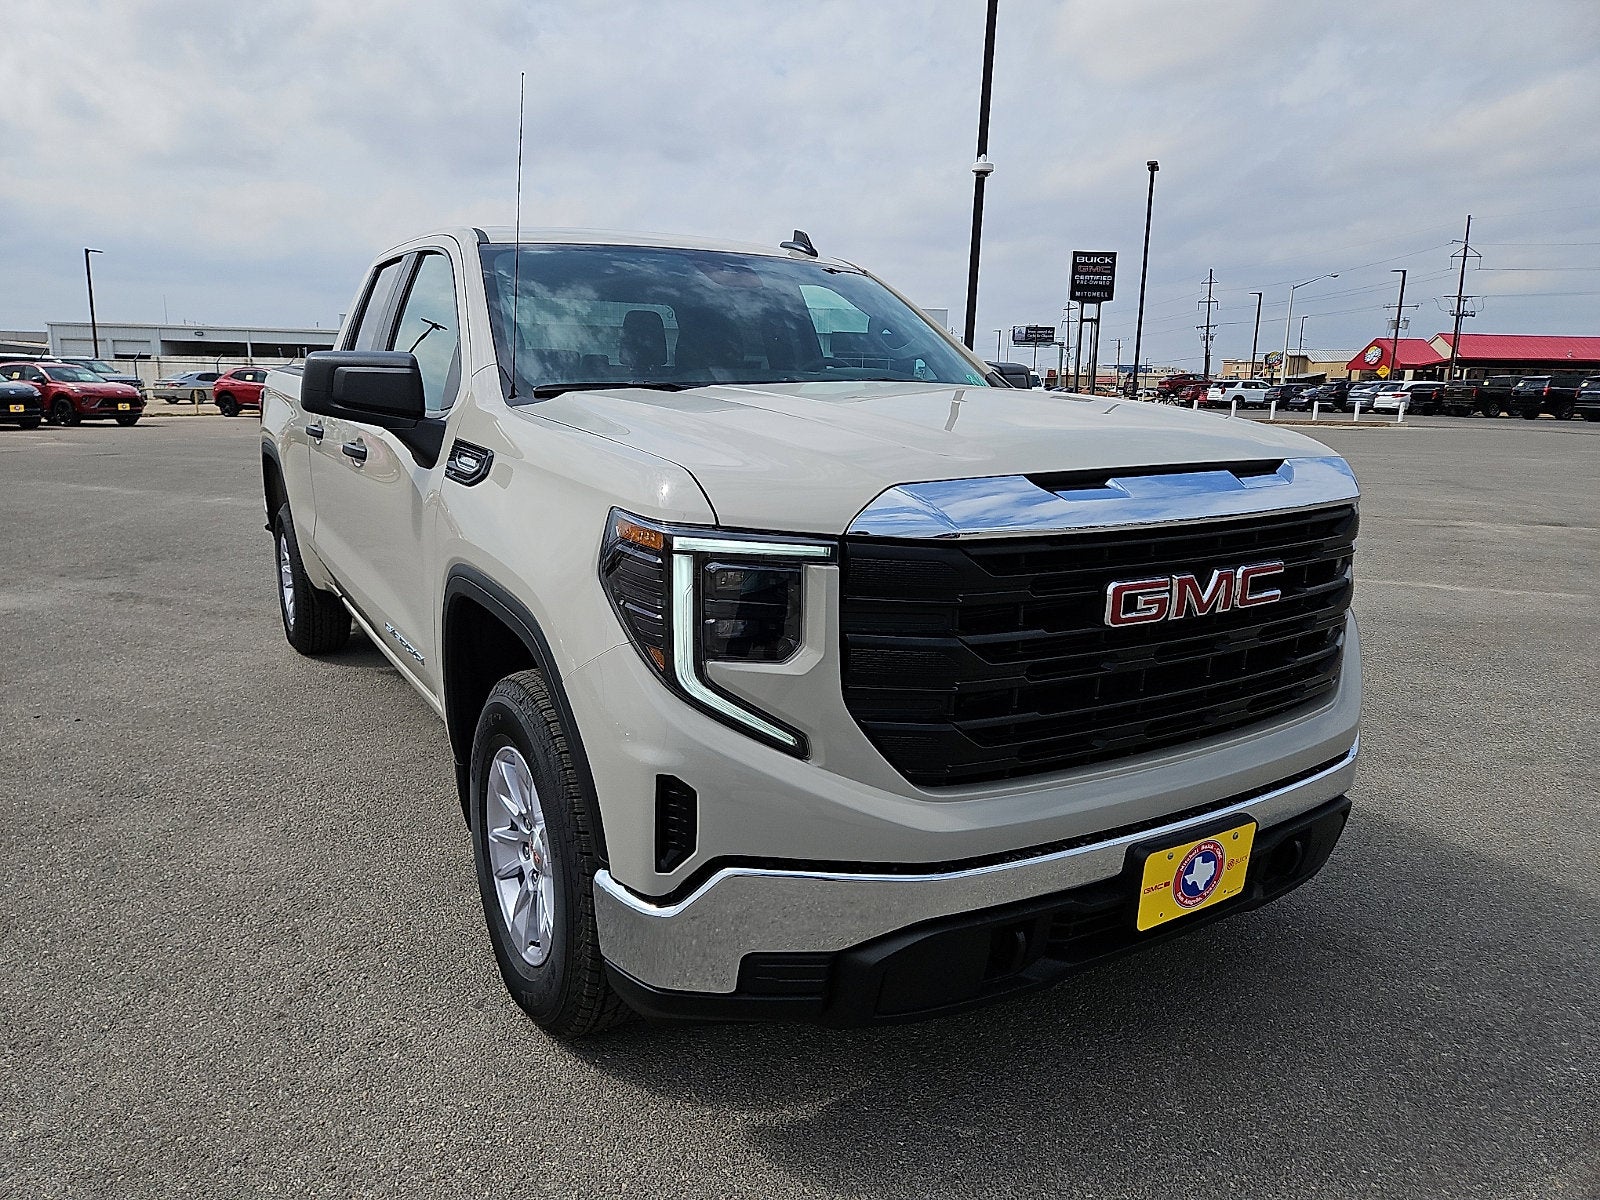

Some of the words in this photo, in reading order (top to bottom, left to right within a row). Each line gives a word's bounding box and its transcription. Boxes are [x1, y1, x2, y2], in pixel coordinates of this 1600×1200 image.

[1078, 265, 1111, 273] GMC
[1104, 561, 1285, 628] GMC
[1143, 882, 1164, 895] GMC
